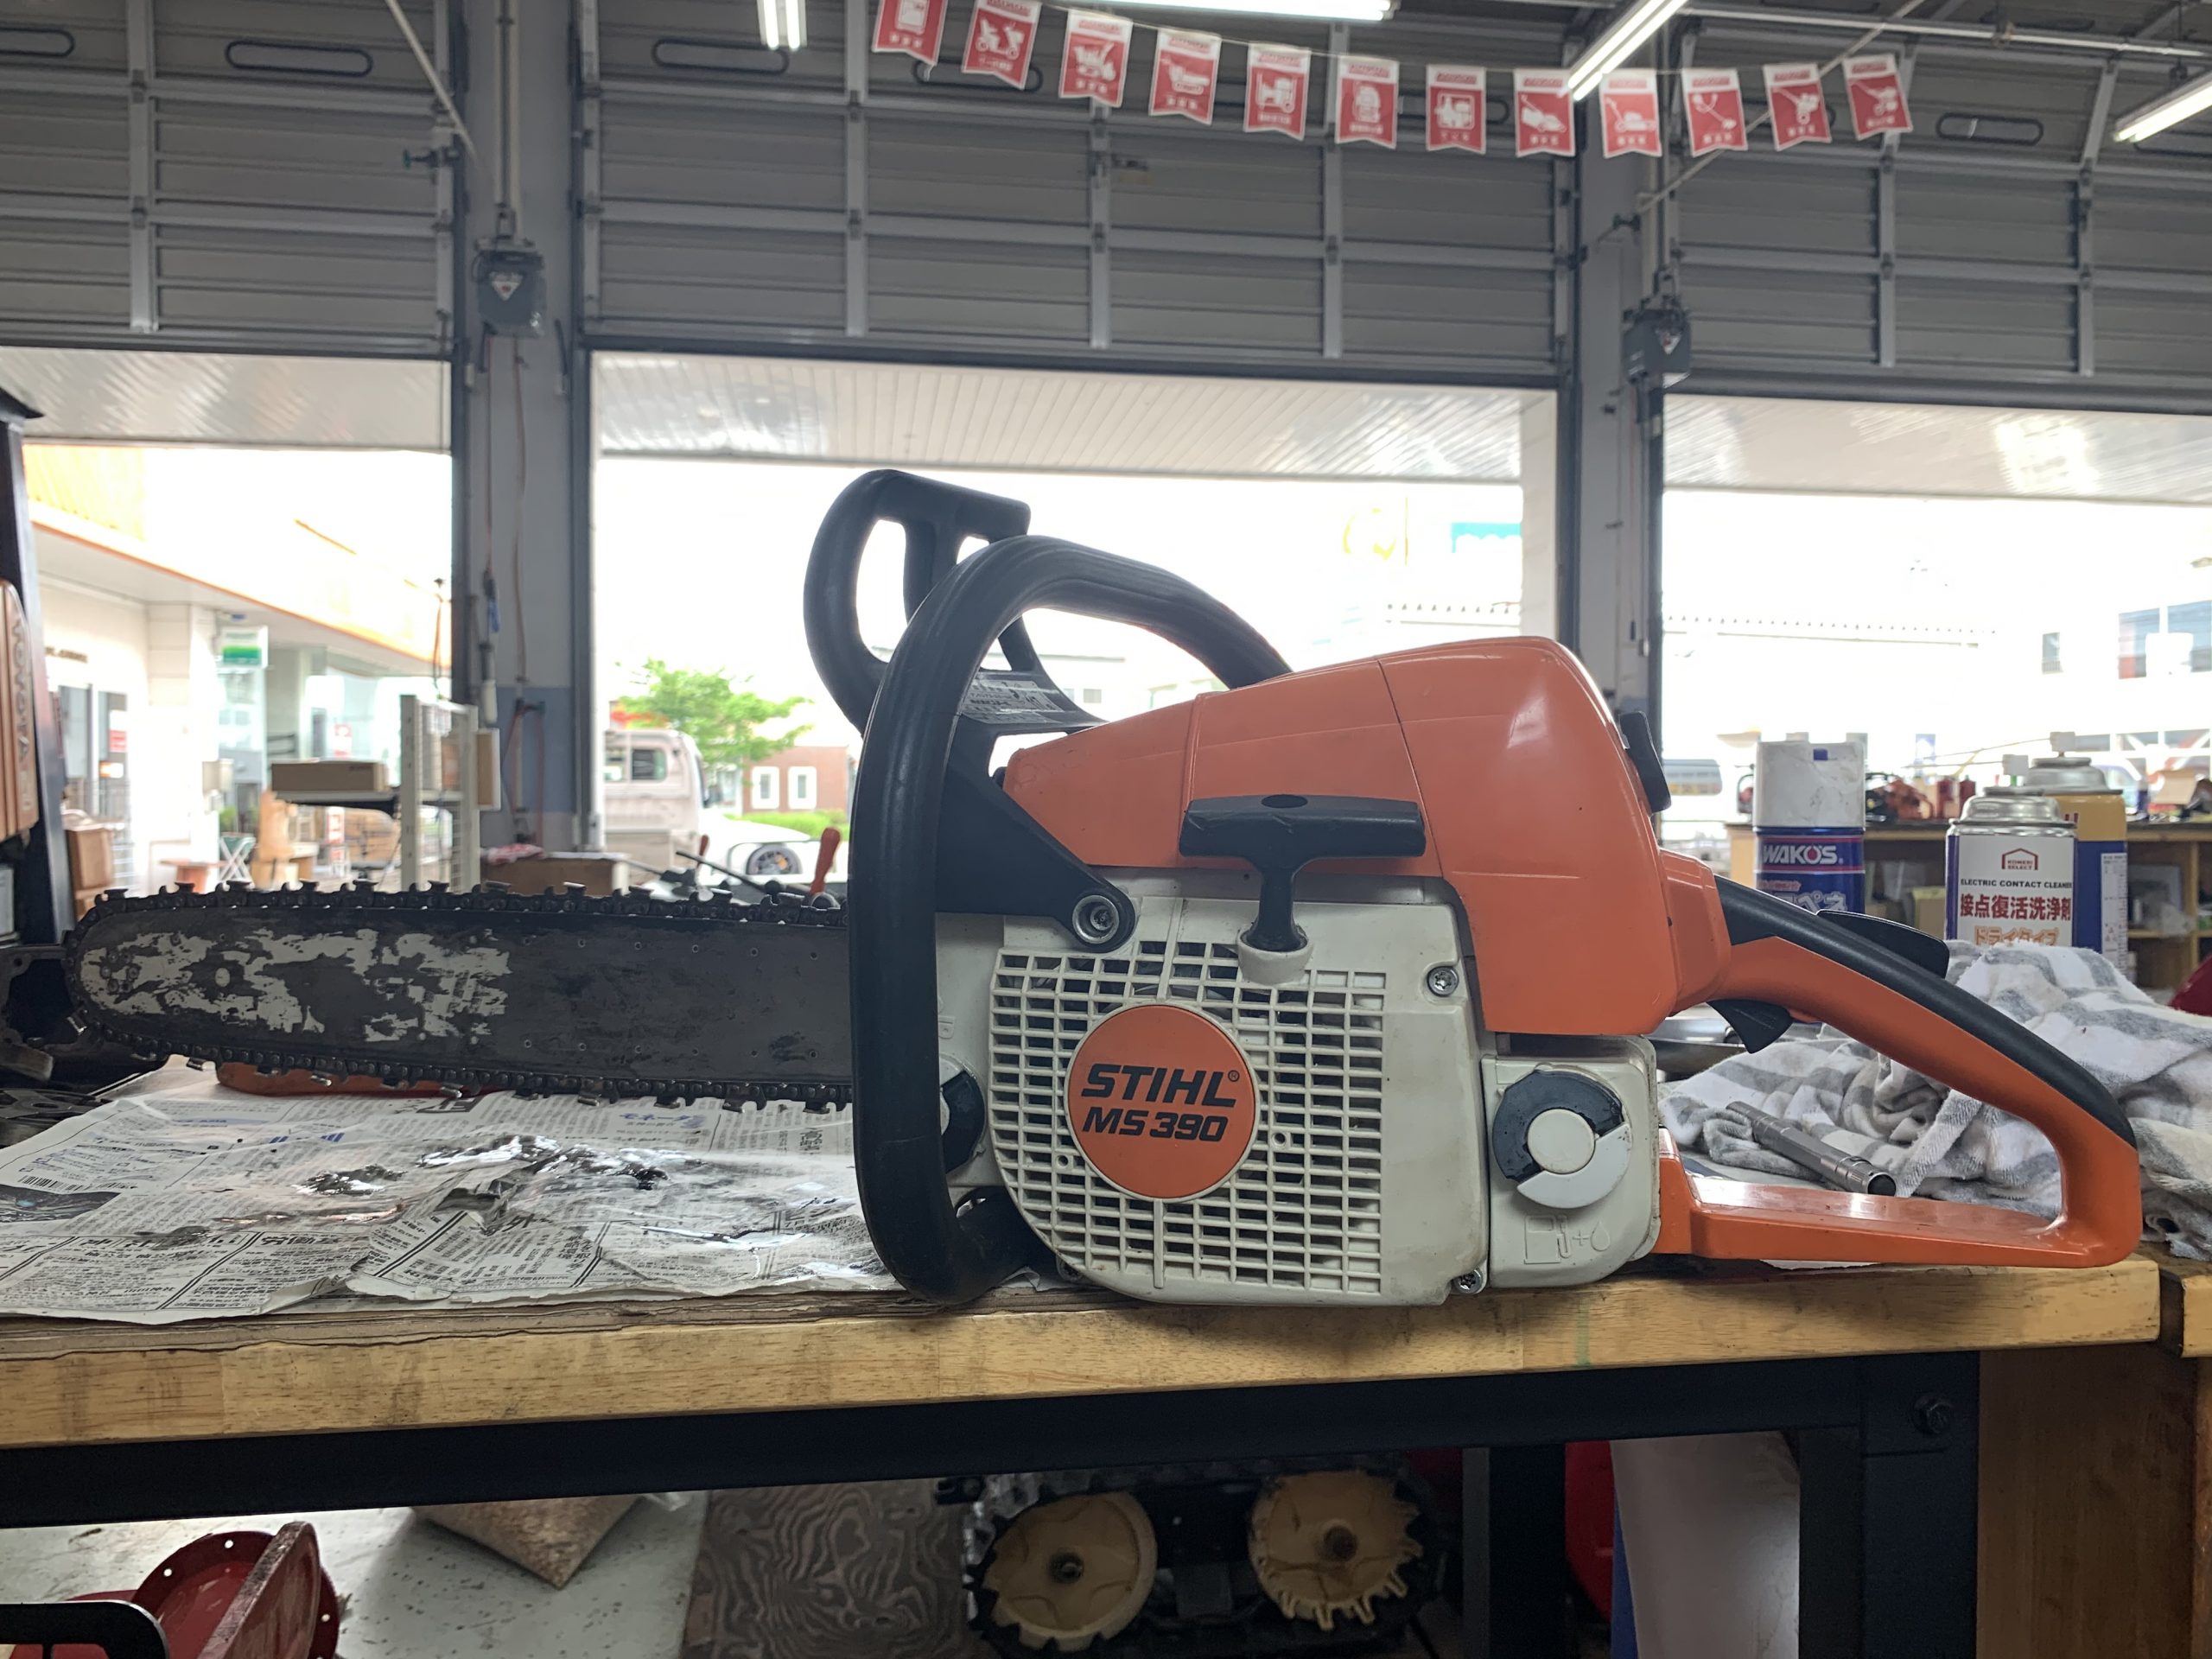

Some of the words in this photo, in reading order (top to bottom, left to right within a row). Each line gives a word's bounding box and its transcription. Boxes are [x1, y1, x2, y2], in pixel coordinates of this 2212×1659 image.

[1961, 879, 1998, 887] ELECTRIC
[1999, 880, 2042, 889] CONTACT
[1960, 893, 2071, 921] 接点復活洗浄剤
[1081, 1063, 1236, 1108] STIHL
[1083, 1106, 1149, 1136] MS
[1149, 1111, 1229, 1142] 390
